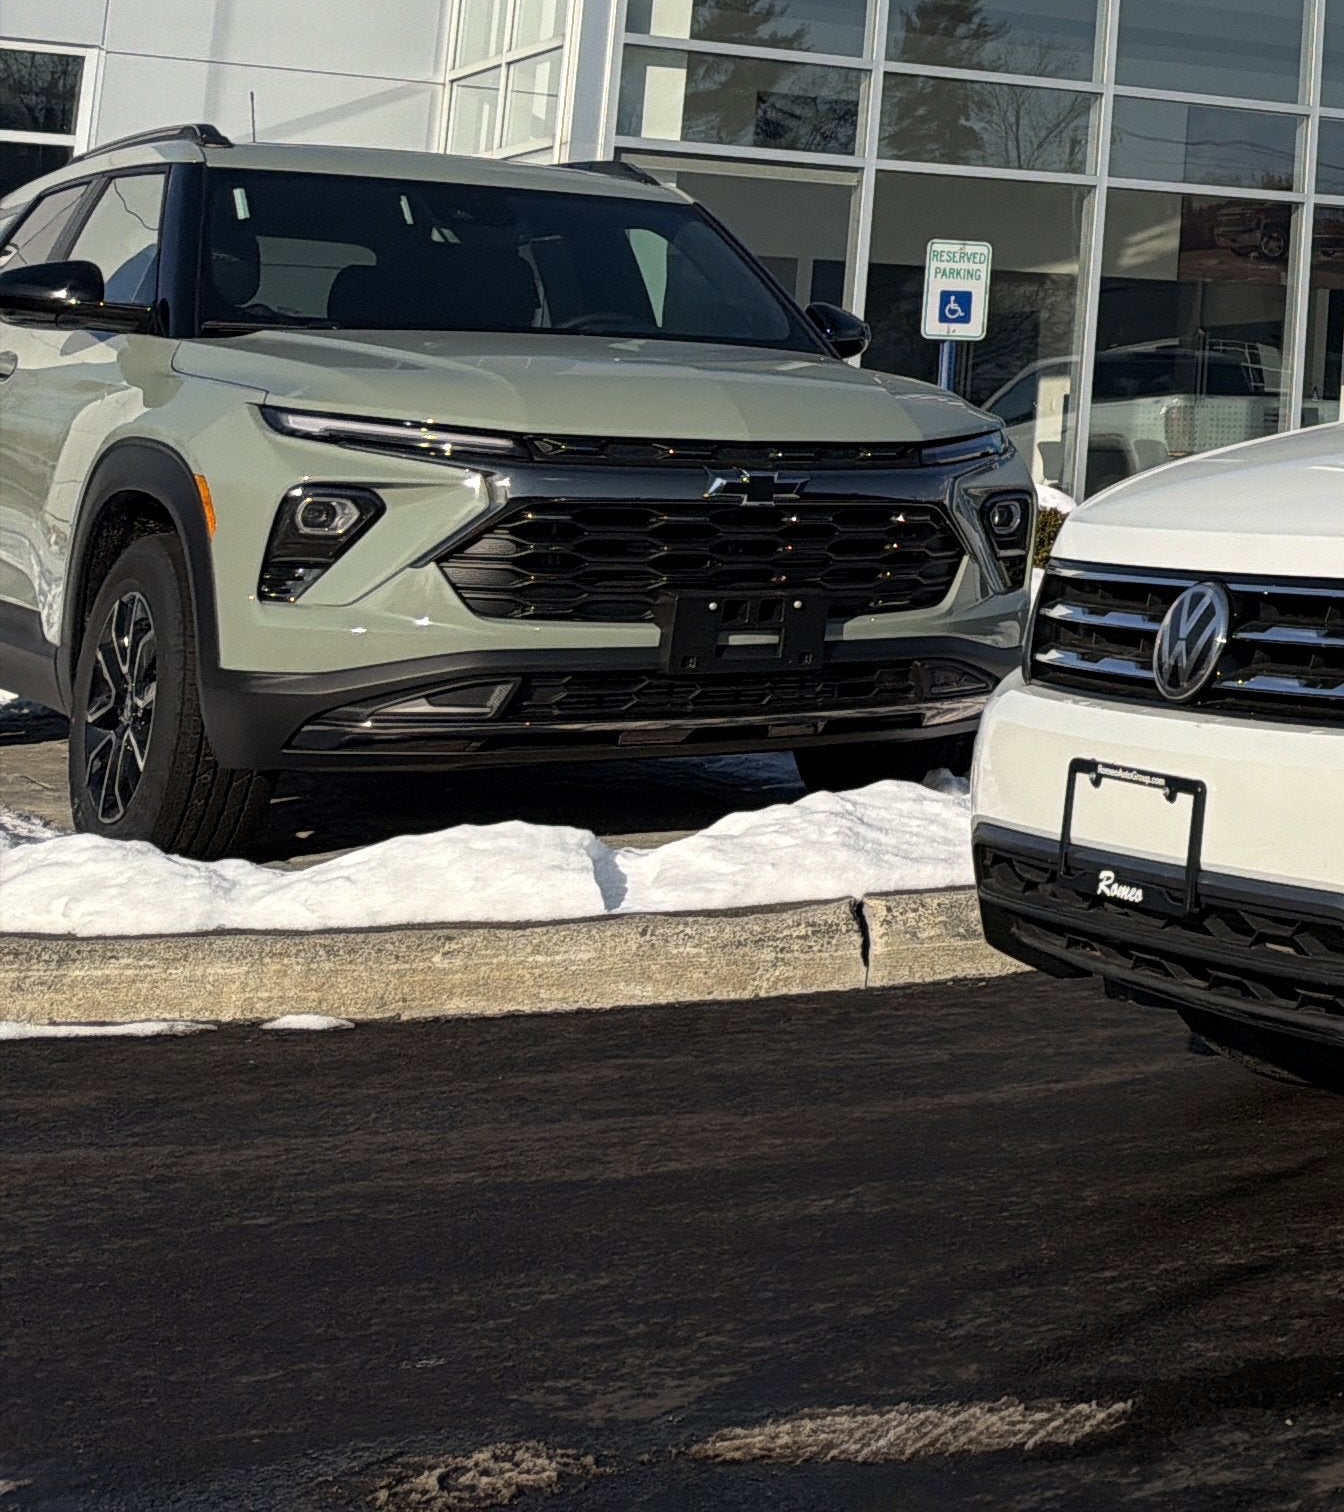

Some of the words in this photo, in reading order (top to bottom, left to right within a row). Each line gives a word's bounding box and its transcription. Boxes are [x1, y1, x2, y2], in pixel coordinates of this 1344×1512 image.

[931, 249, 987, 265] RESERVED
[934, 266, 982, 281] PARKING
[1096, 870, 1144, 903] Romeo
